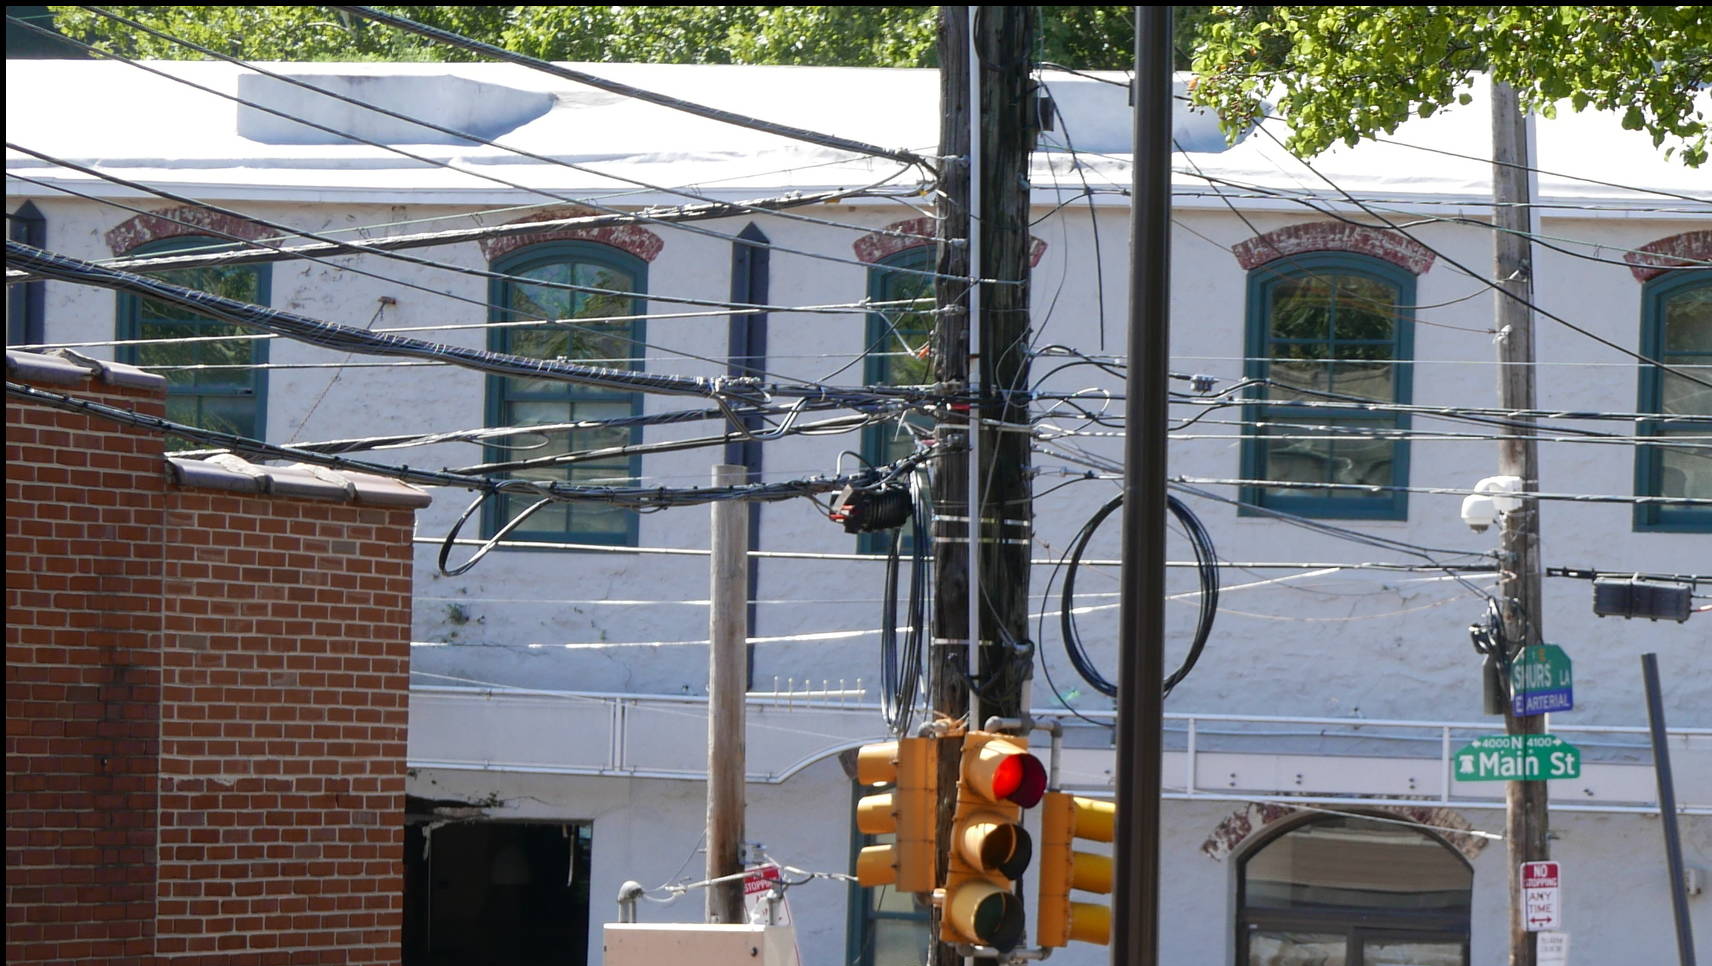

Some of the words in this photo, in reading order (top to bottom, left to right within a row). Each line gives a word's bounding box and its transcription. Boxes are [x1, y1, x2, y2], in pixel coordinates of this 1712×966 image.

[1514, 664, 1552, 689] SHURS
[1560, 669, 1570, 686] LA
[1527, 693, 1570, 711] ARTERIAL
[1482, 738, 1510, 748] 4000
[1511, 737, 1523, 749] N
[1526, 737, 1551, 747] 4100
[1479, 752, 1539, 777] Main
[1551, 752, 1575, 775] St
[1533, 865, 1548, 878] NO
[1528, 891, 1552, 902] ANY
[1528, 904, 1552, 914] TIME
